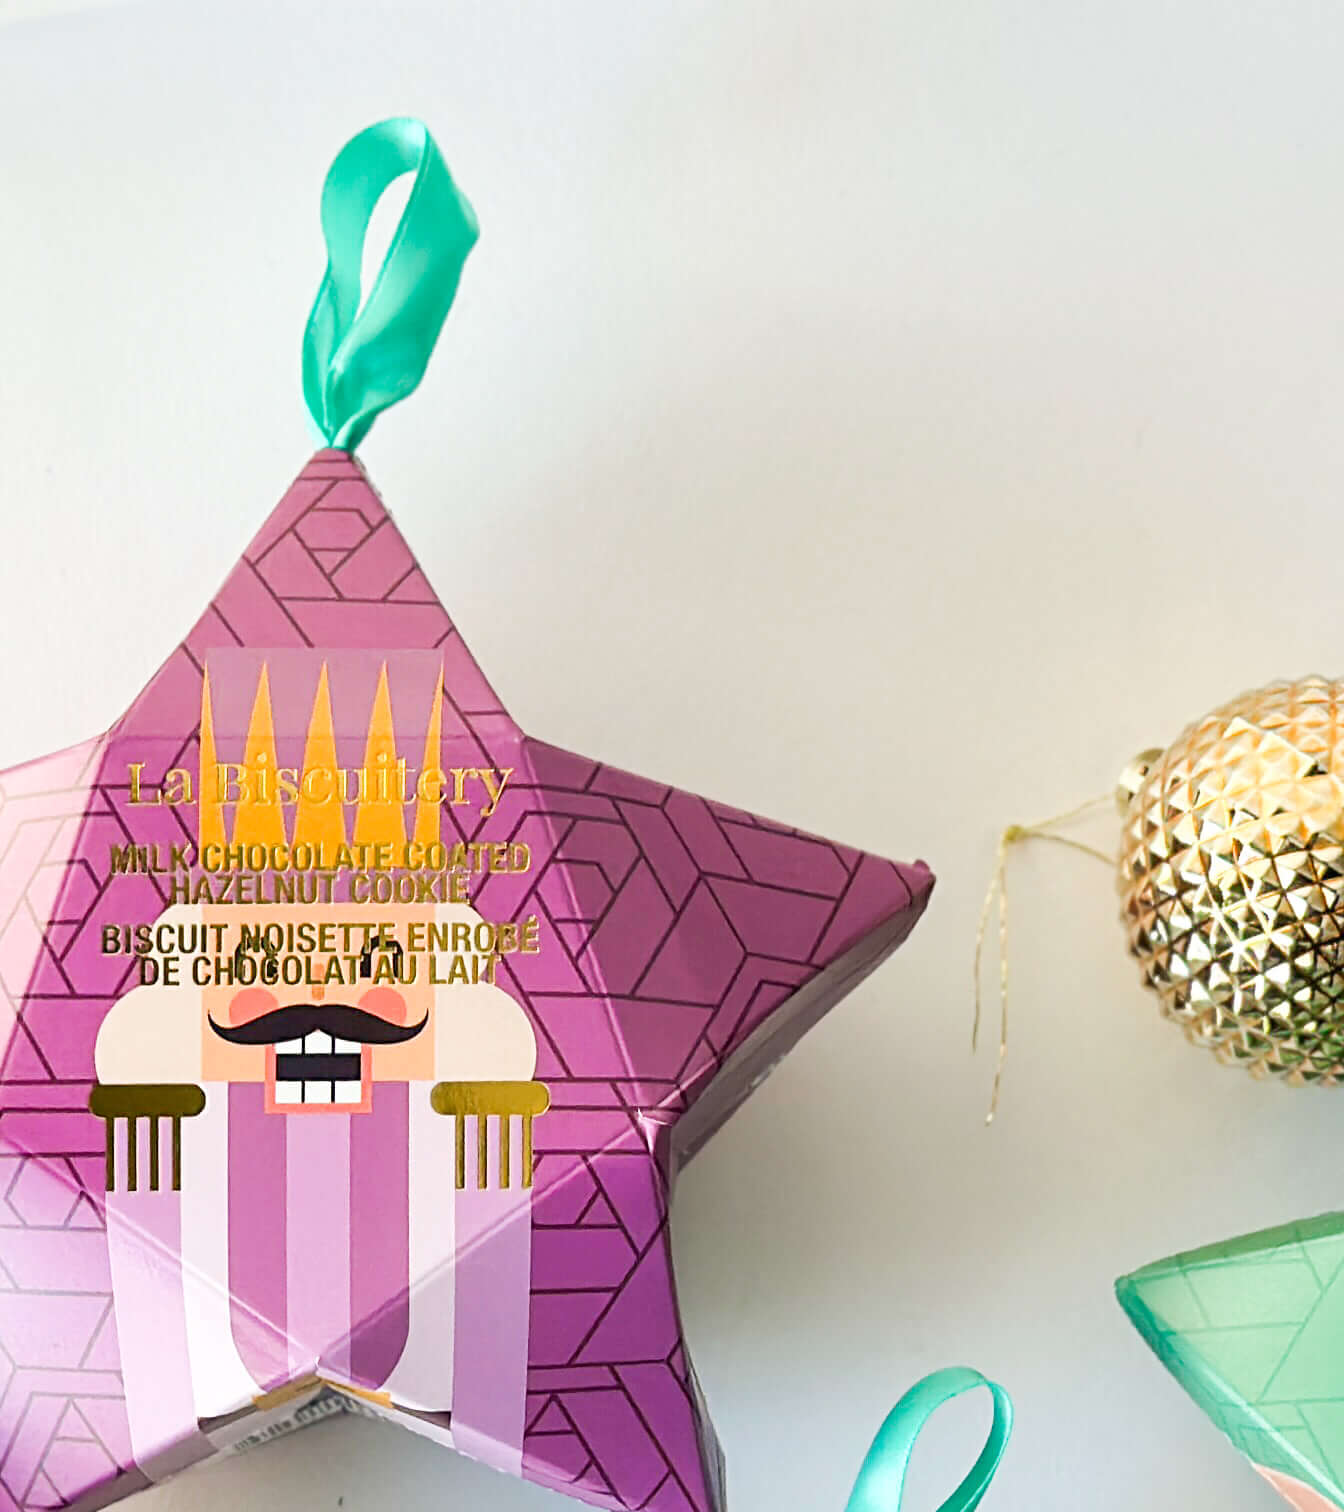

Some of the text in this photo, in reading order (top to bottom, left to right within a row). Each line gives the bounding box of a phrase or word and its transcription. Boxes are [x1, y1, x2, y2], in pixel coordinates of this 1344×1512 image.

[126, 753, 514, 817] La Biscuitery
[110, 841, 532, 874] MILK CHOCOLATE COATED
[169, 873, 472, 906] HAZELNUT COOKIE
[101, 914, 540, 955] BISCUIT NOISETTE ENROBÉ
[140, 955, 501, 986] DE CHOCOLAT AU LAIT
